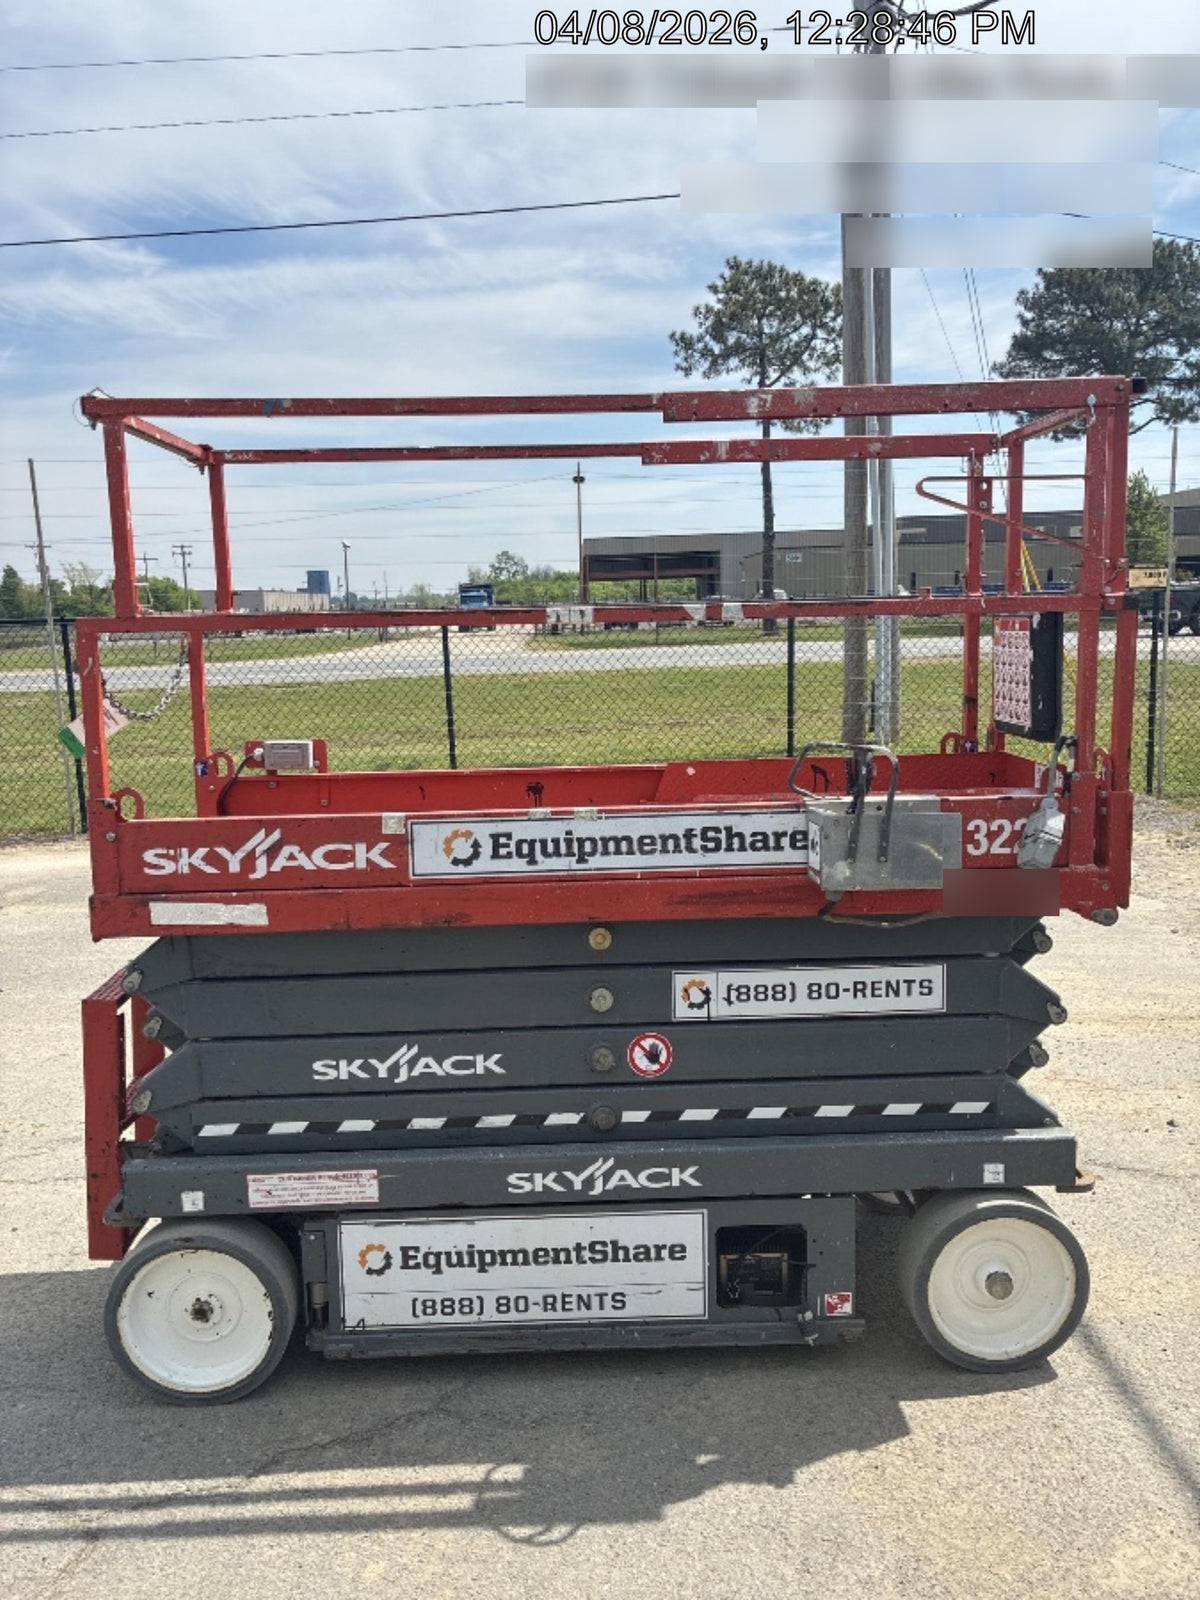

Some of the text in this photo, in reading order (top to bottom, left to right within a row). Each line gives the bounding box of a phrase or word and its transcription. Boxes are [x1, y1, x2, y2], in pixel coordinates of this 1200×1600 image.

[142, 828, 397, 879] SKYJACK
[489, 825, 809, 867] EquipmentShare
[727, 978, 934, 1004] (888) 80-RENTS
[312, 1043, 506, 1084] SKYJACK
[506, 1157, 703, 1195] SKYJACK
[400, 1239, 688, 1275] EquipmentShare
[411, 1291, 627, 1318] (888) 80-RENTS
